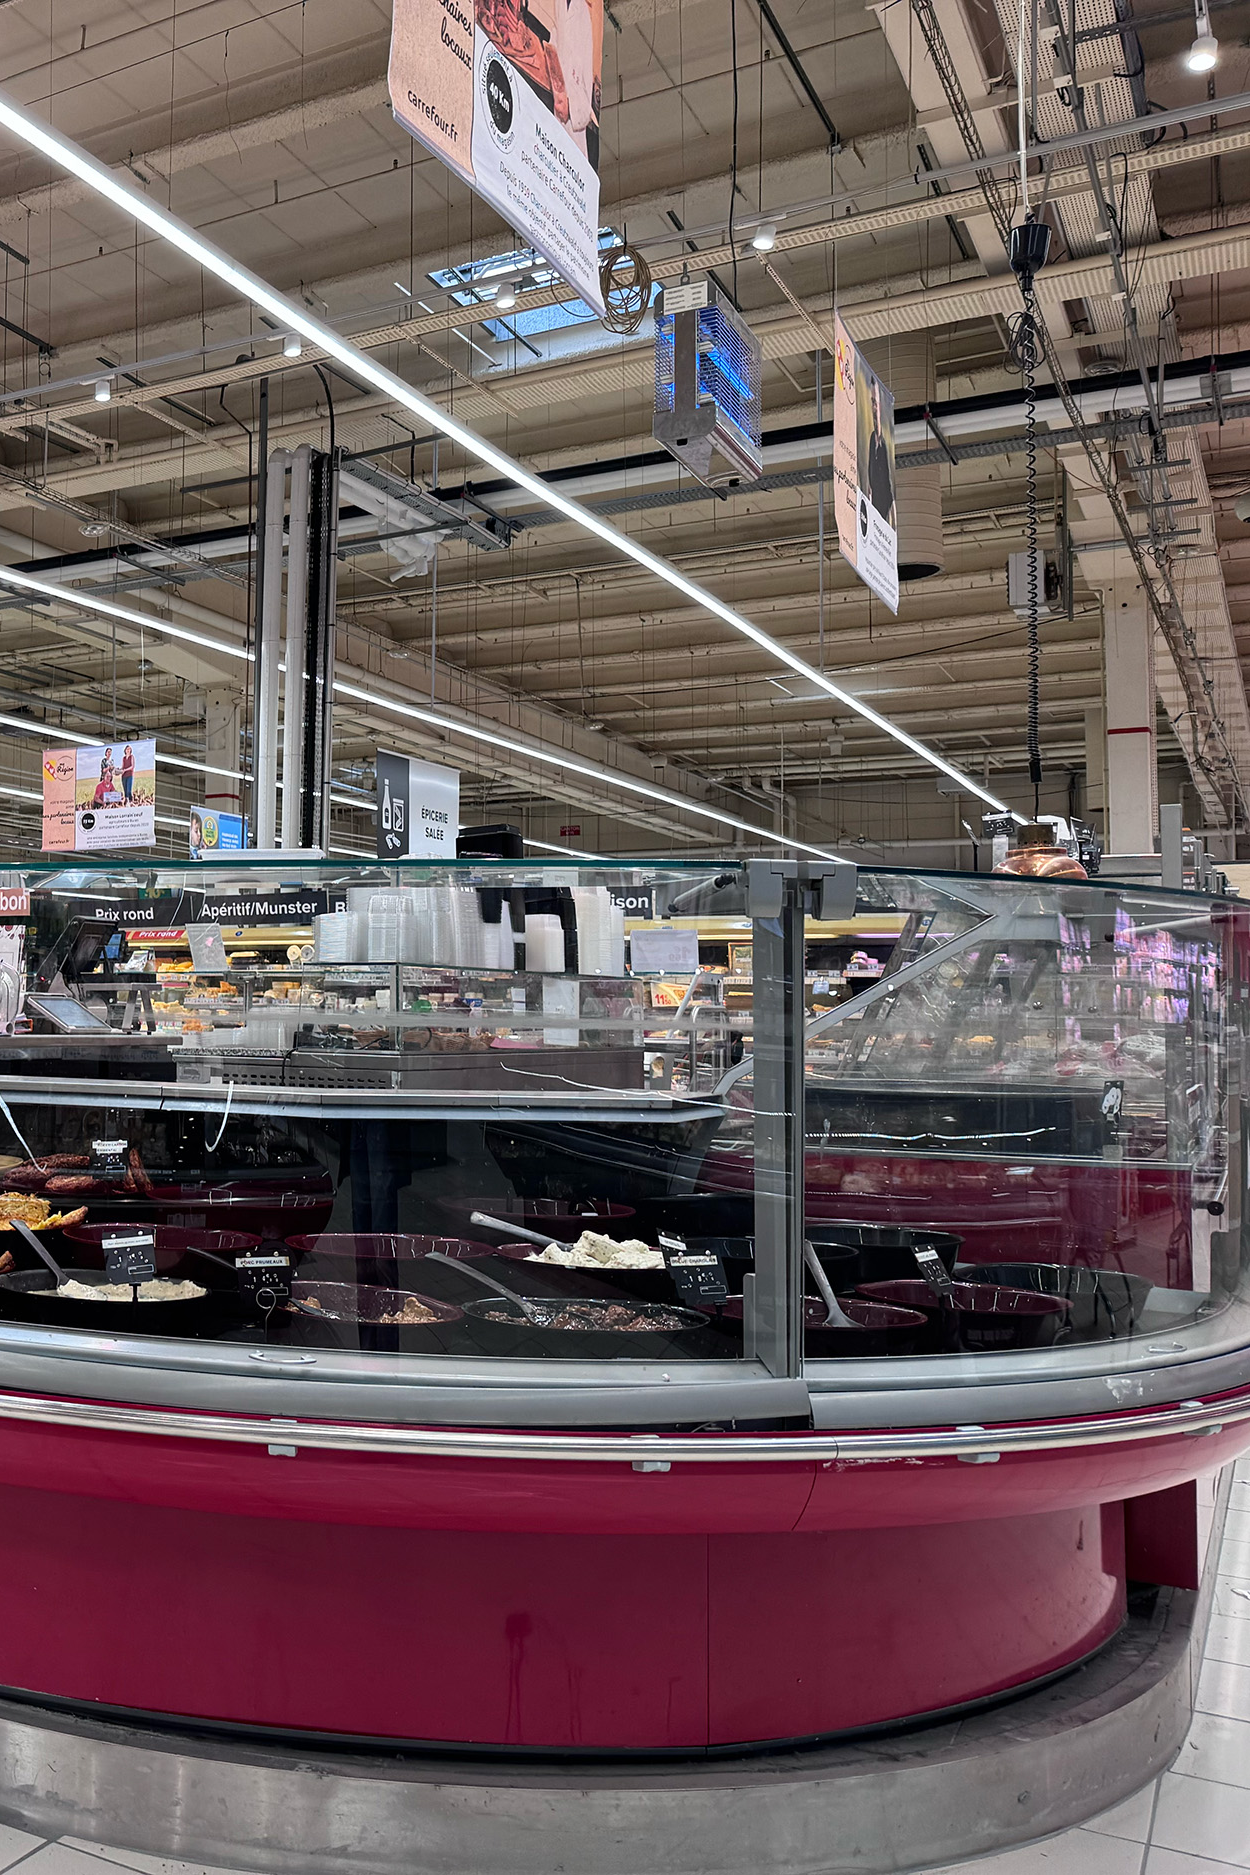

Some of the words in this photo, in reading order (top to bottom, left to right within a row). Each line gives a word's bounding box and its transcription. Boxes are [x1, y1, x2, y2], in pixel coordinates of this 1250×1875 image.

[440, 16, 472, 71] locaux
[407, 90, 458, 142] carrefour.fr
[535, 122, 557, 159] Maison
[421, 805, 449, 824] ÉPICERIE
[424, 826, 445, 841] SALÉE
[200, 900, 318, 920] Apéritif/Munster
[610, 894, 649, 910] ison
[95, 908, 121, 921] Prix
[122, 906, 154, 921] rond
